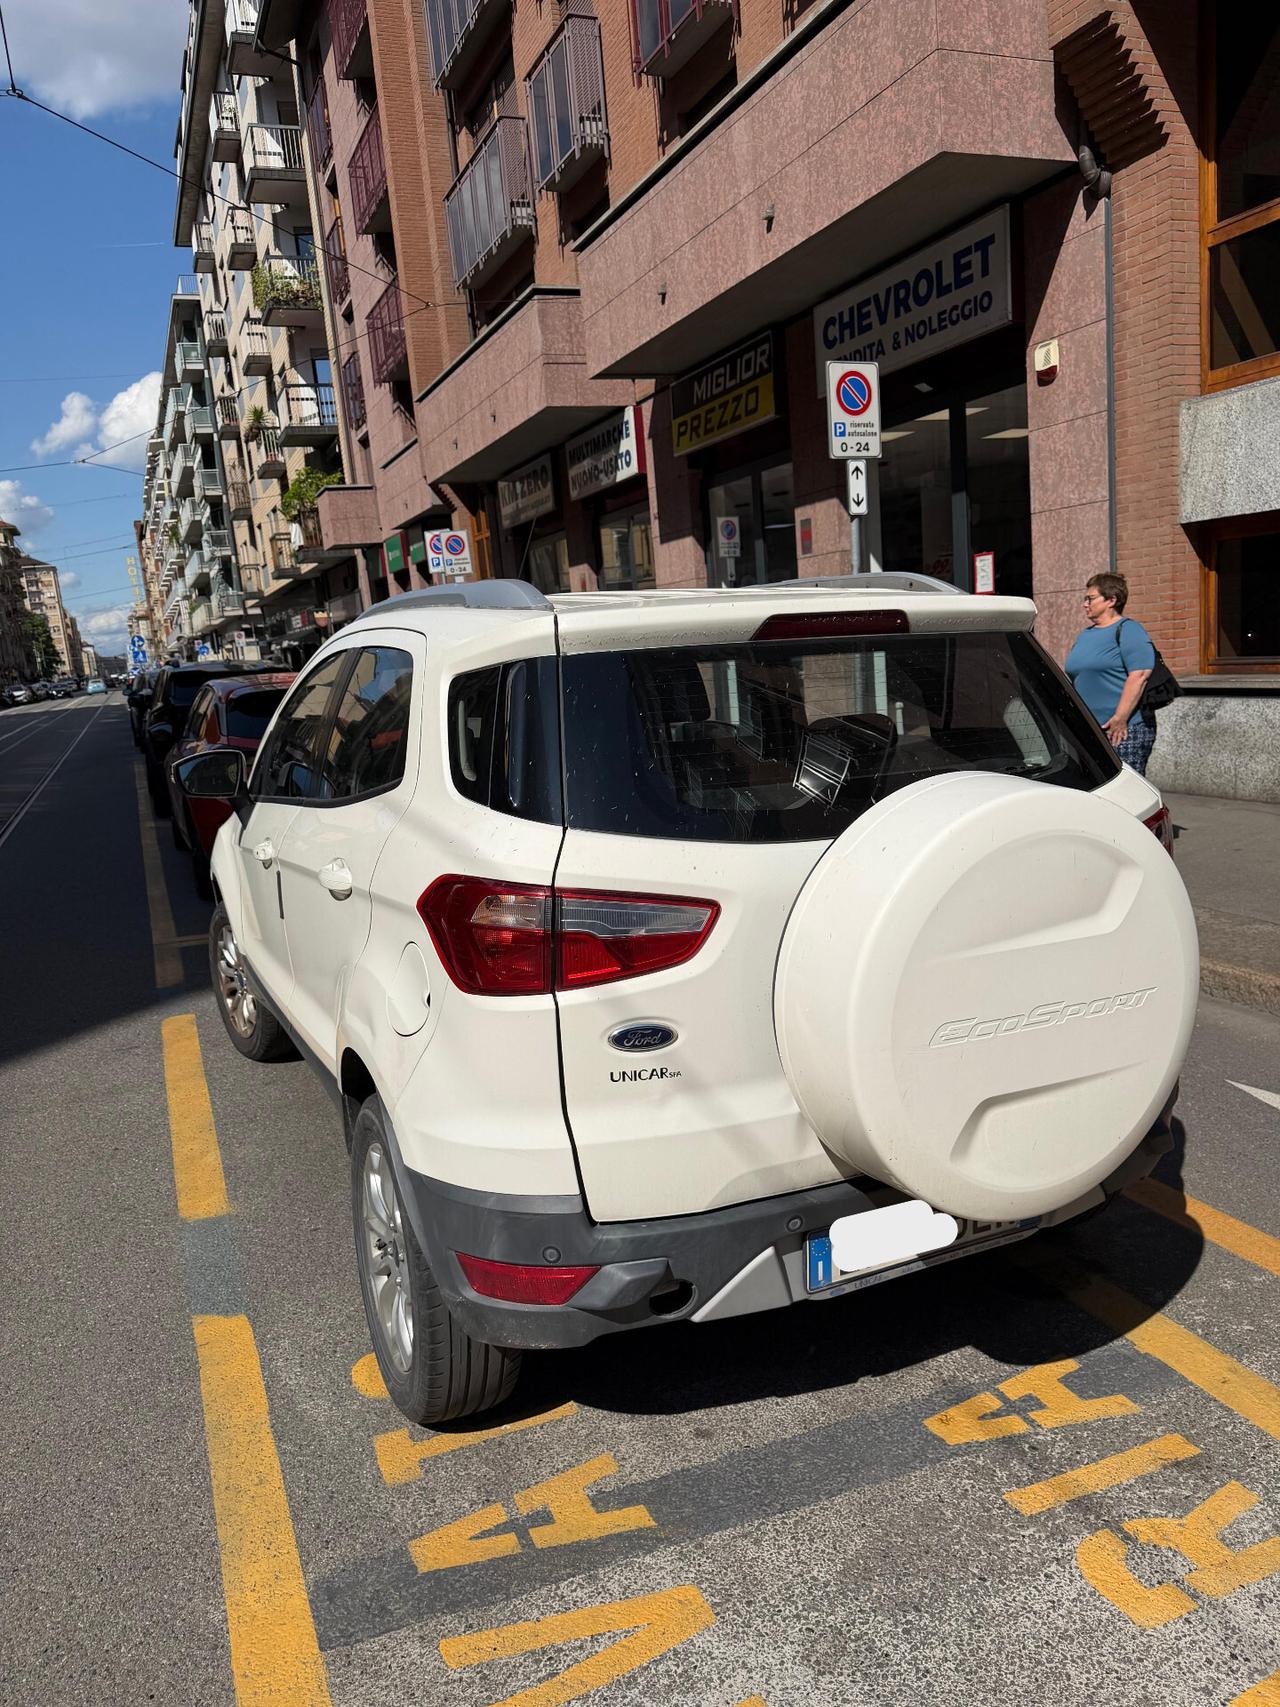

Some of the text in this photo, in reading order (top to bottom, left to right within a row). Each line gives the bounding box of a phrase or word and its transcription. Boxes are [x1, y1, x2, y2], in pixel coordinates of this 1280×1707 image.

[823, 233, 996, 350] CHEVROLET
[892, 331, 902, 351] &
[904, 290, 993, 346] NOLEGGIO
[693, 343, 770, 405] MIGLIOR
[568, 420, 630, 463] MULTIMARCHE
[676, 385, 760, 448] PREZZO
[520, 464, 549, 500] ZERO
[570, 449, 632, 495] NUOVO-USATO
[623, 1029, 662, 1047] Ford
